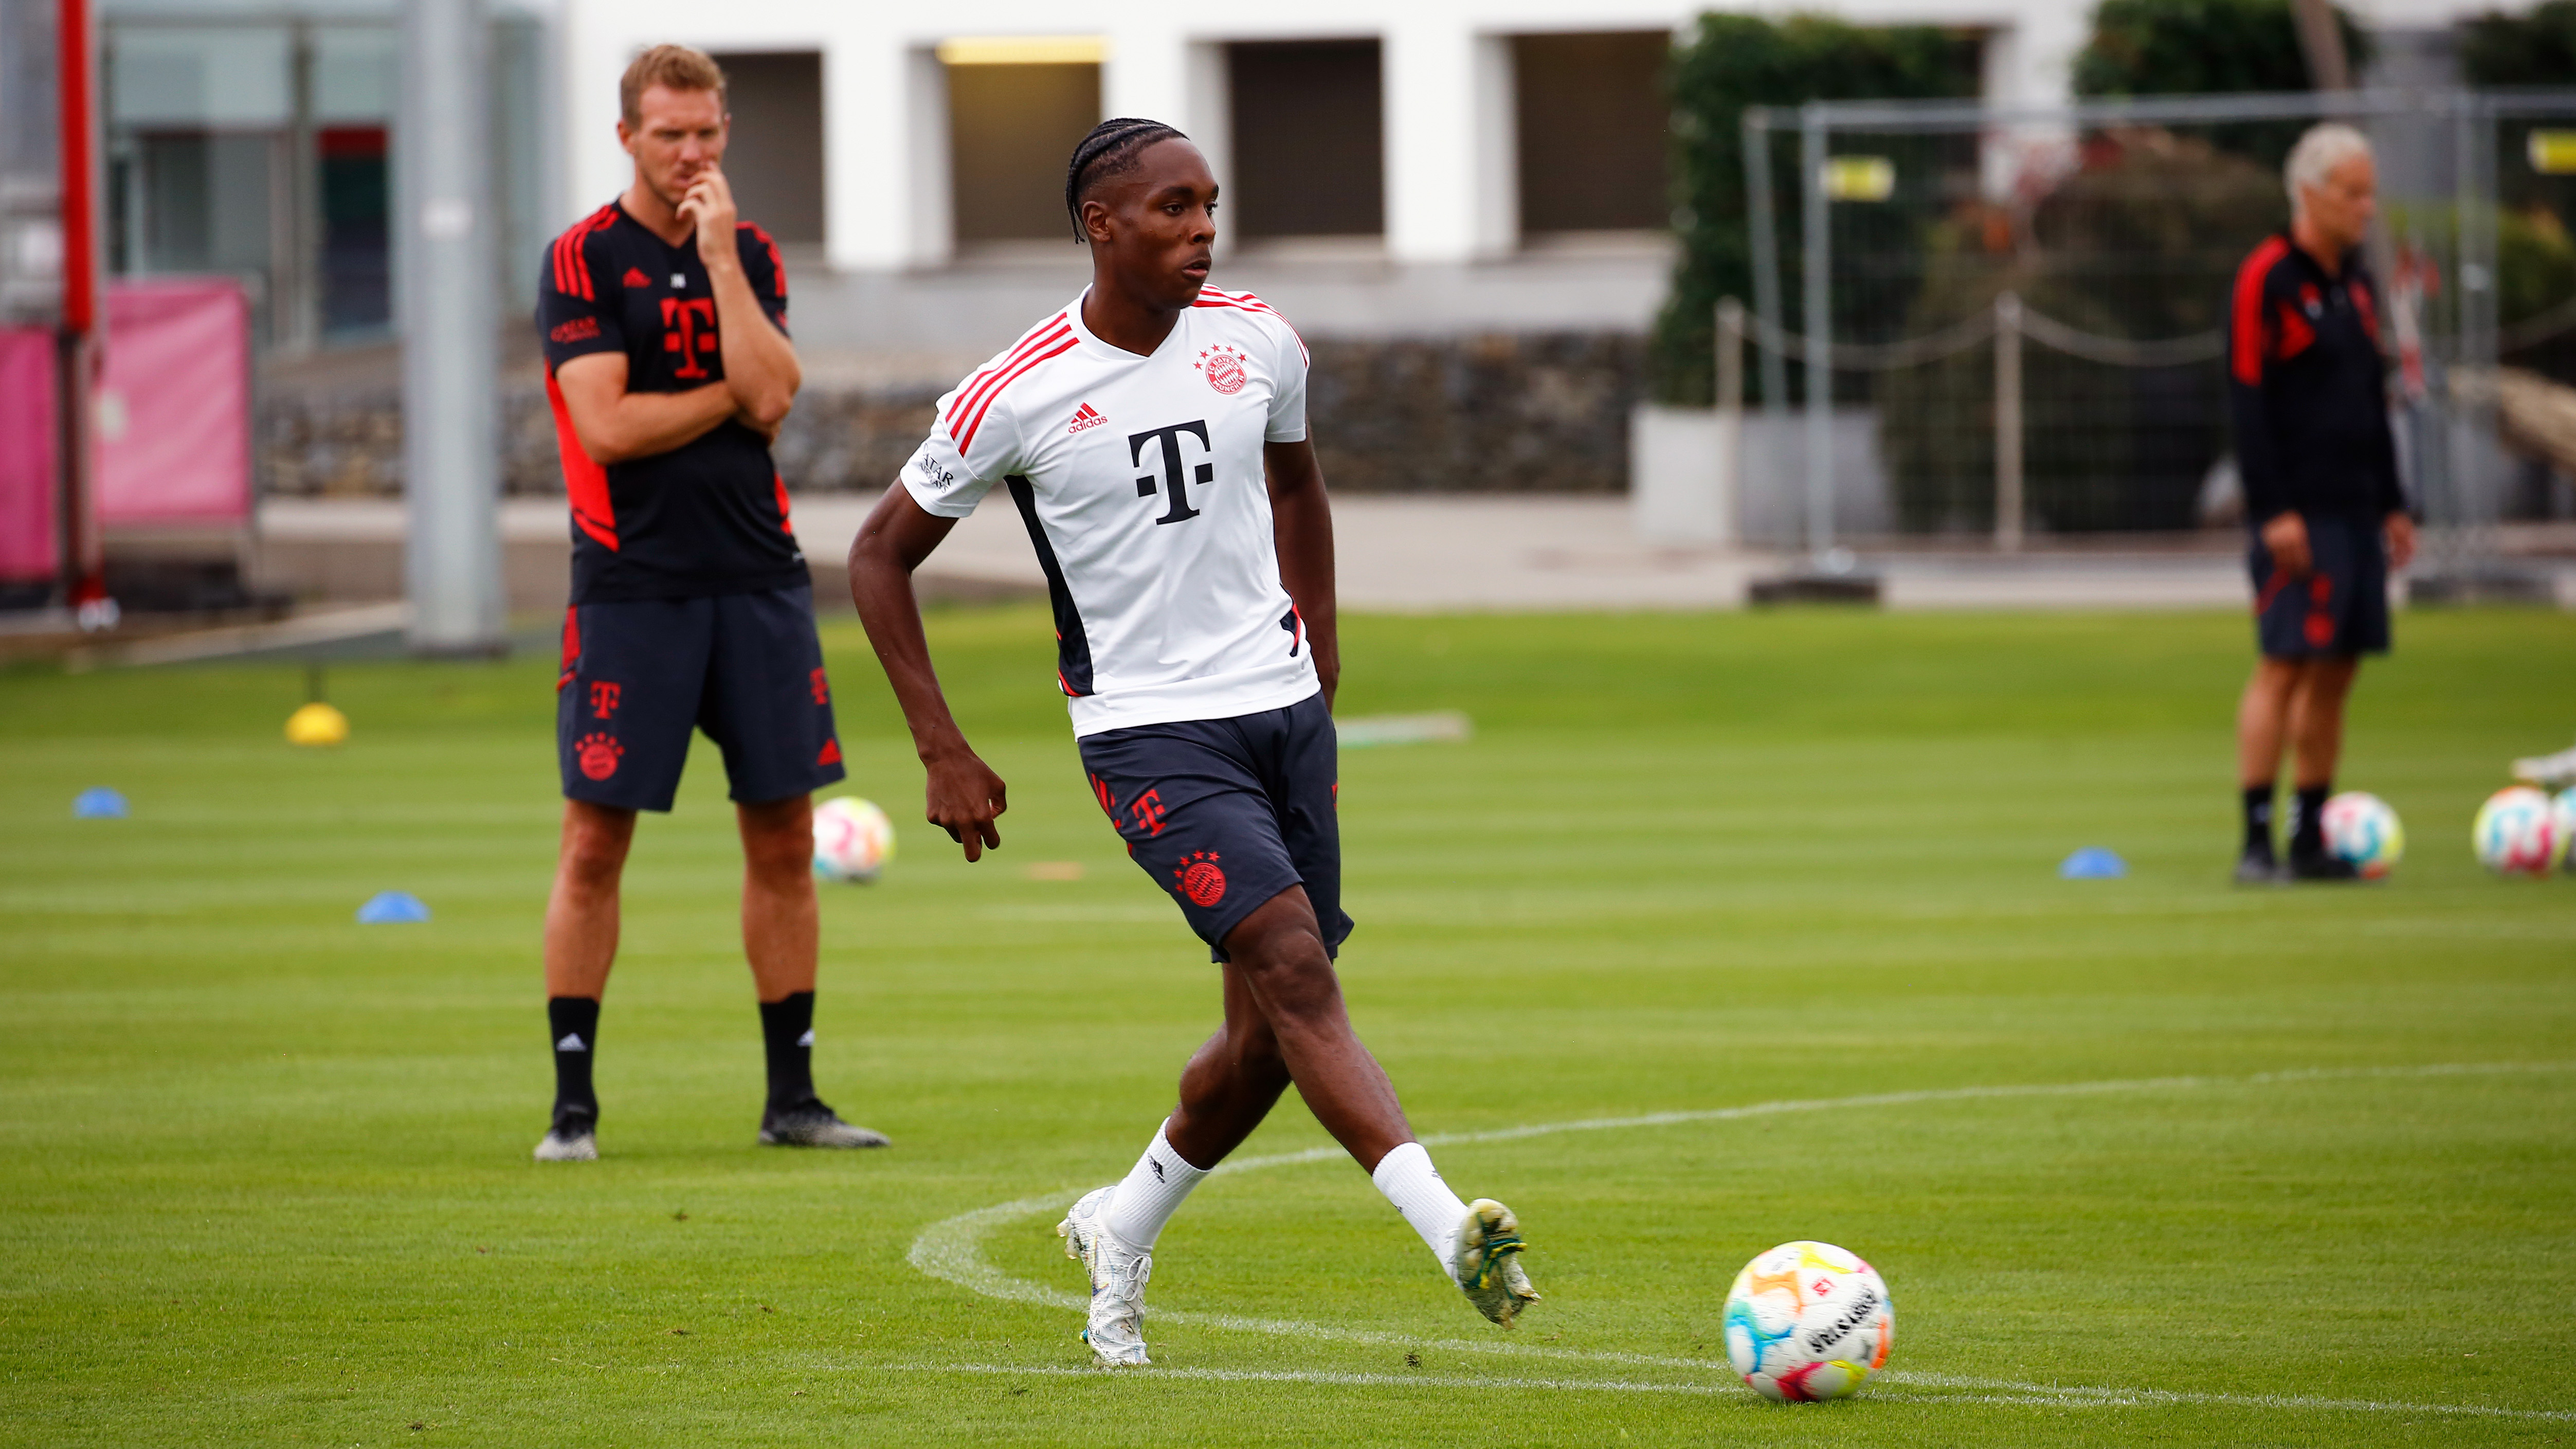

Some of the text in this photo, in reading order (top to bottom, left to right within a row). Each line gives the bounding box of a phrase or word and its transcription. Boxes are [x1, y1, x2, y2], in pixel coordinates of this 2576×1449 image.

[660, 297, 717, 379] T
[1212, 356, 1240, 370] BAYERN
[1068, 416, 1108, 434] adidas
[1128, 420, 1213, 525] T
[590, 680, 622, 719] T
[1132, 789, 1167, 837] T
